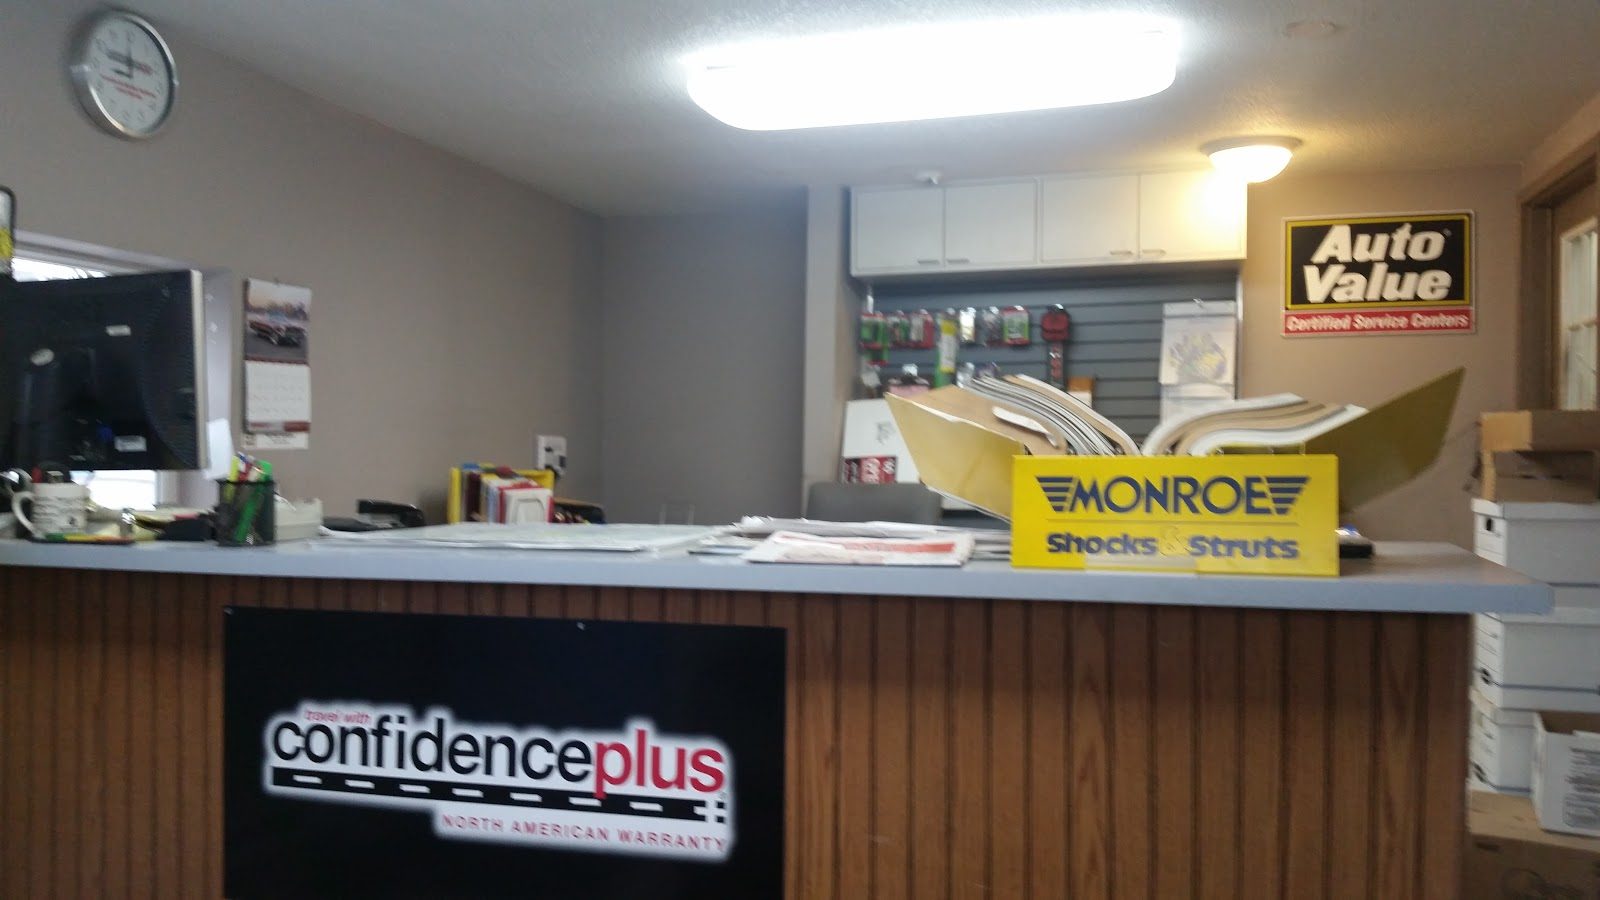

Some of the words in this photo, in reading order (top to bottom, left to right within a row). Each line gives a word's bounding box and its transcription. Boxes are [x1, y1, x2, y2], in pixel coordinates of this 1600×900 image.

[1310, 222, 1446, 264] Auto
[1303, 262, 1453, 303] Value
[1286, 314, 1351, 332] Certified
[1353, 312, 1409, 330] Service
[1410, 311, 1470, 329] Centers
[1069, 475, 1274, 516] MONROE
[1046, 532, 1159, 556] Shocks
[1188, 535, 1300, 560] Struts
[442, 814, 504, 832] NORTH
[511, 821, 609, 841] AMERICAN
[616, 829, 726, 851] WARRANTY
